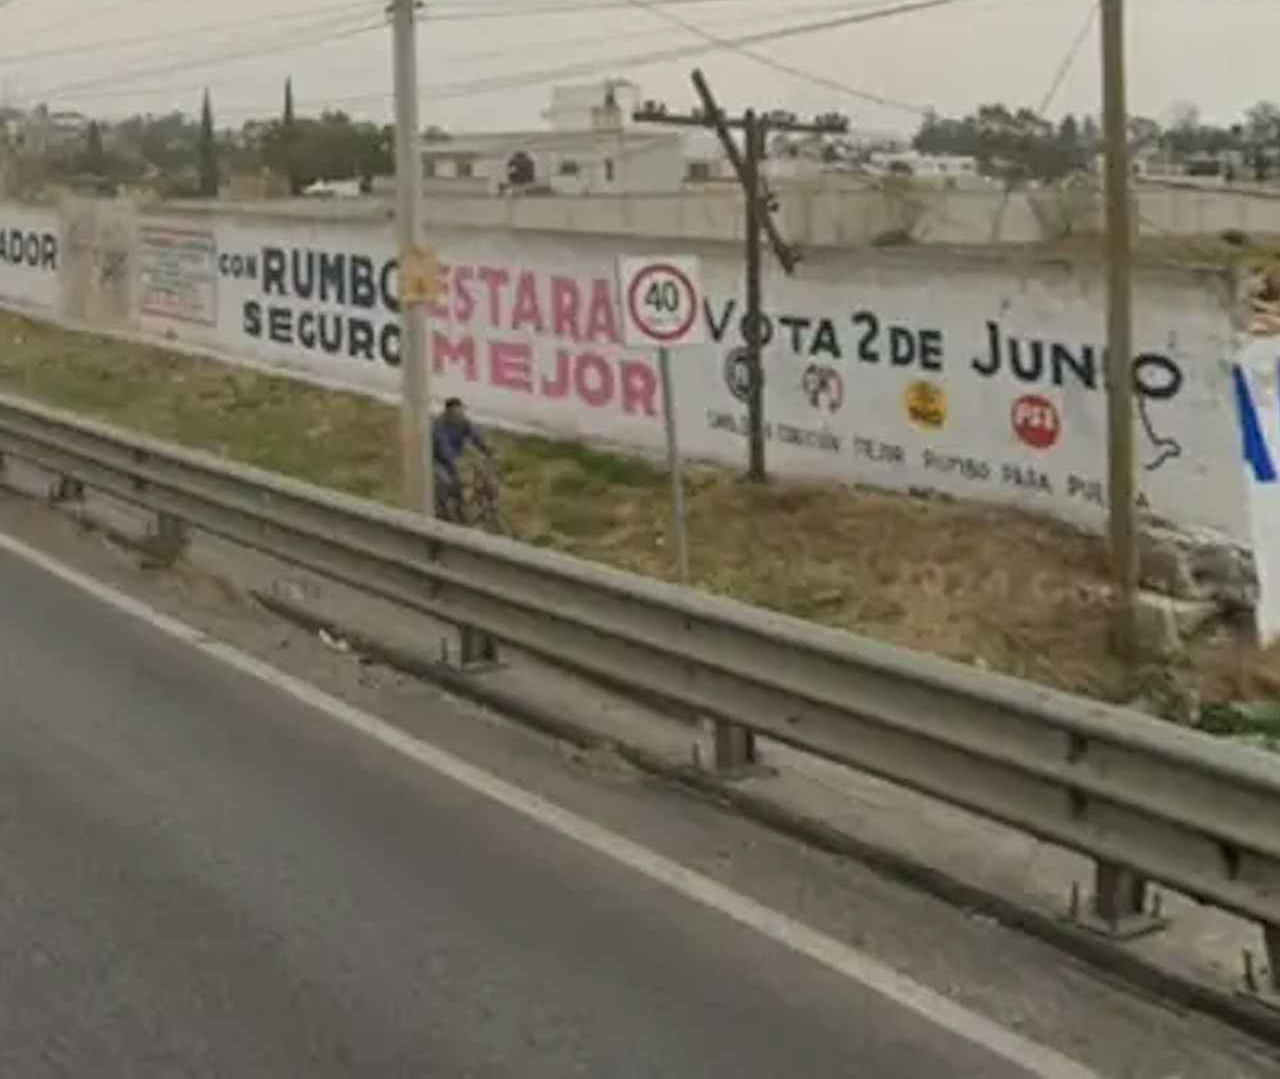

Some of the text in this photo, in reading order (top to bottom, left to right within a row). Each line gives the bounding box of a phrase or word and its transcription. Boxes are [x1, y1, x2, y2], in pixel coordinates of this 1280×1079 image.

[219, 253, 257, 279] CON
[263, 246, 402, 313] RUMBO
[646, 281, 680, 313] 40
[243, 299, 402, 367] SEGURO
[703, 298, 1183, 399] VOTA 2 DE JUNO
[431, 331, 657, 418] MEJOR
